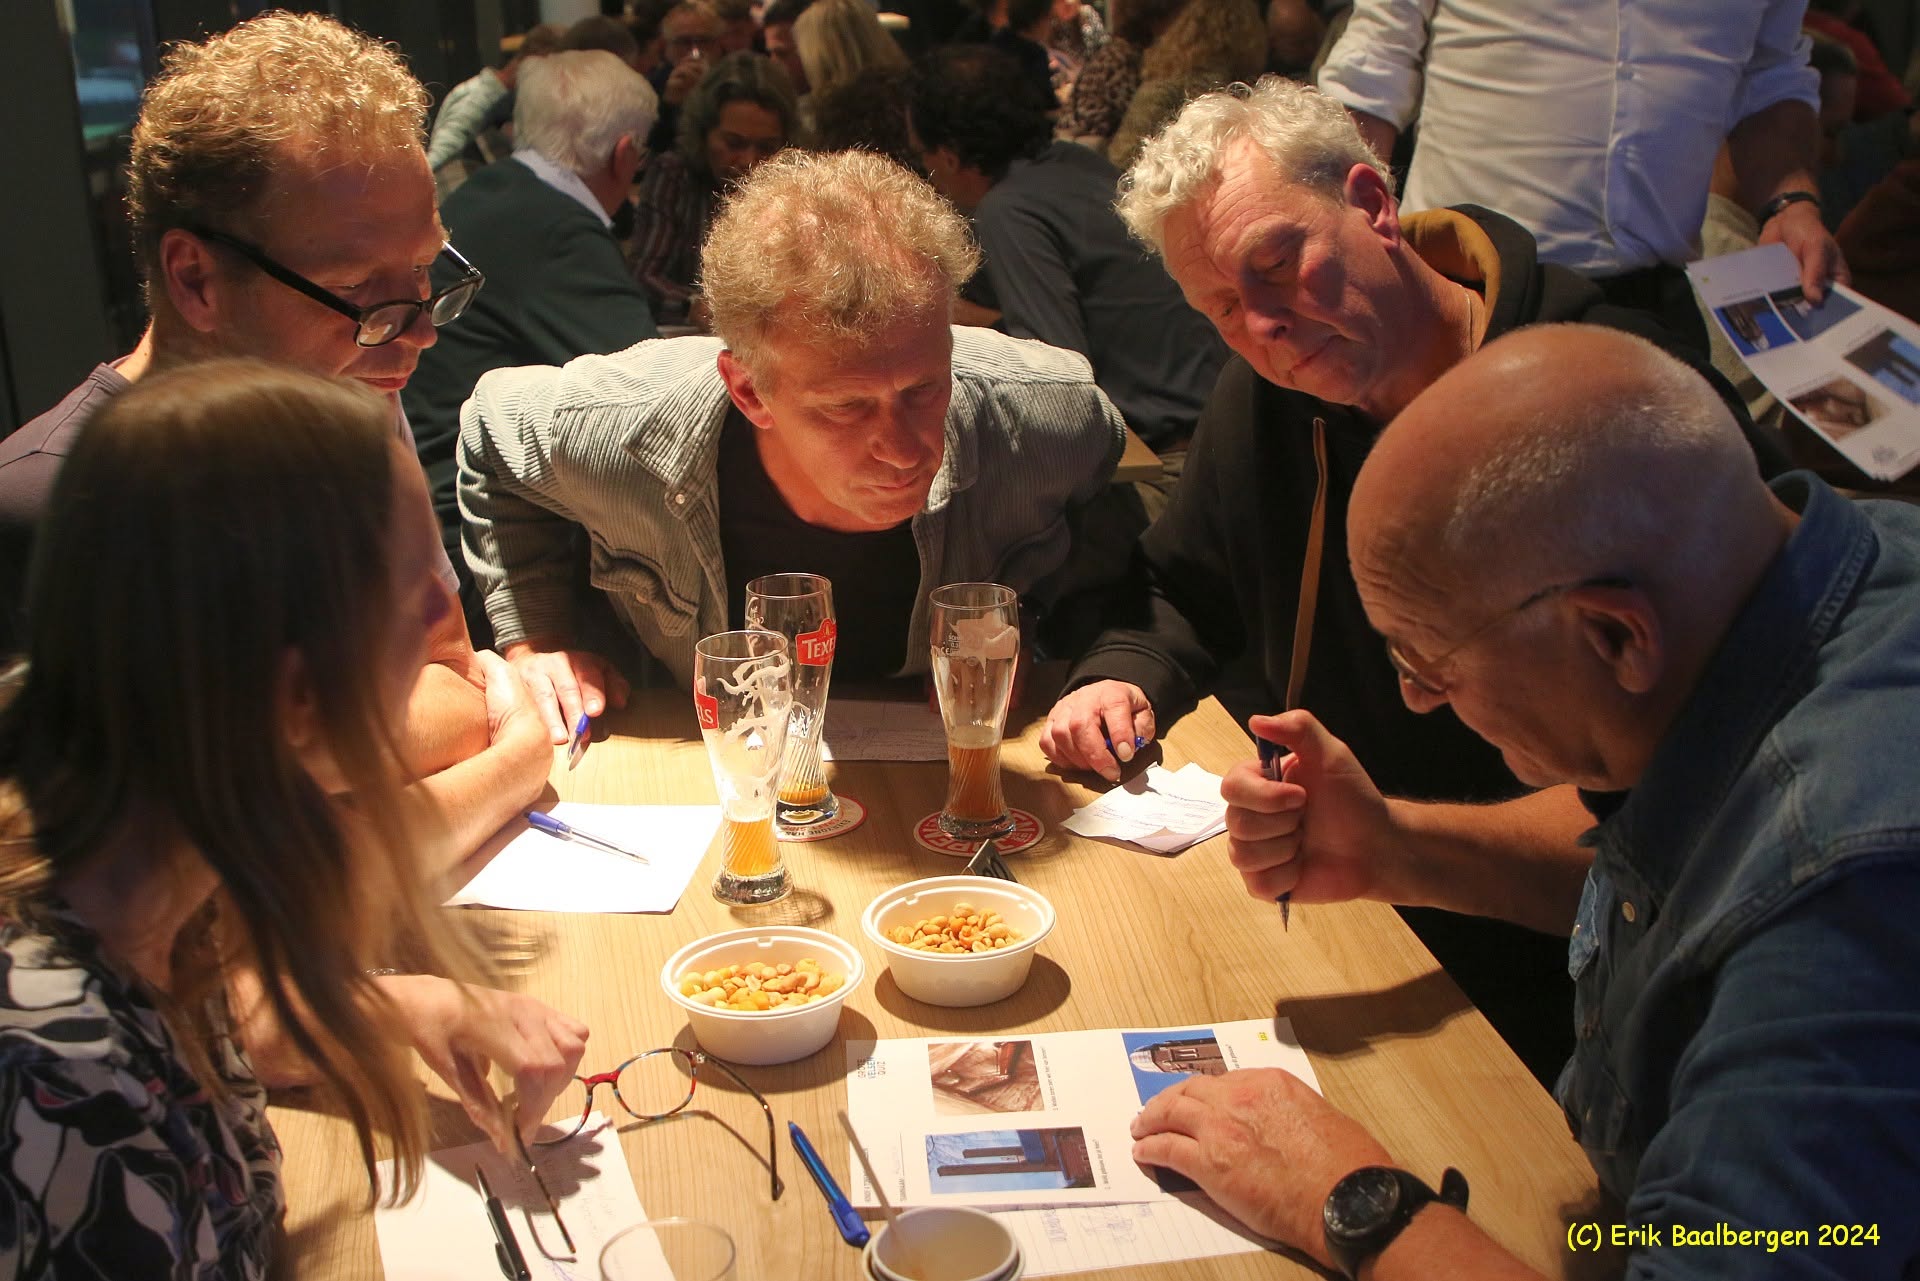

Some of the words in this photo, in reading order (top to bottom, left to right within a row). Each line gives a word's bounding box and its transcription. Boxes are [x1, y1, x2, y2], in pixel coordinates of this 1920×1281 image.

[857, 1058, 866, 1079] GROTE
[867, 1056, 876, 1079] VELSEN
[877, 1061, 886, 1076] QUIZ
